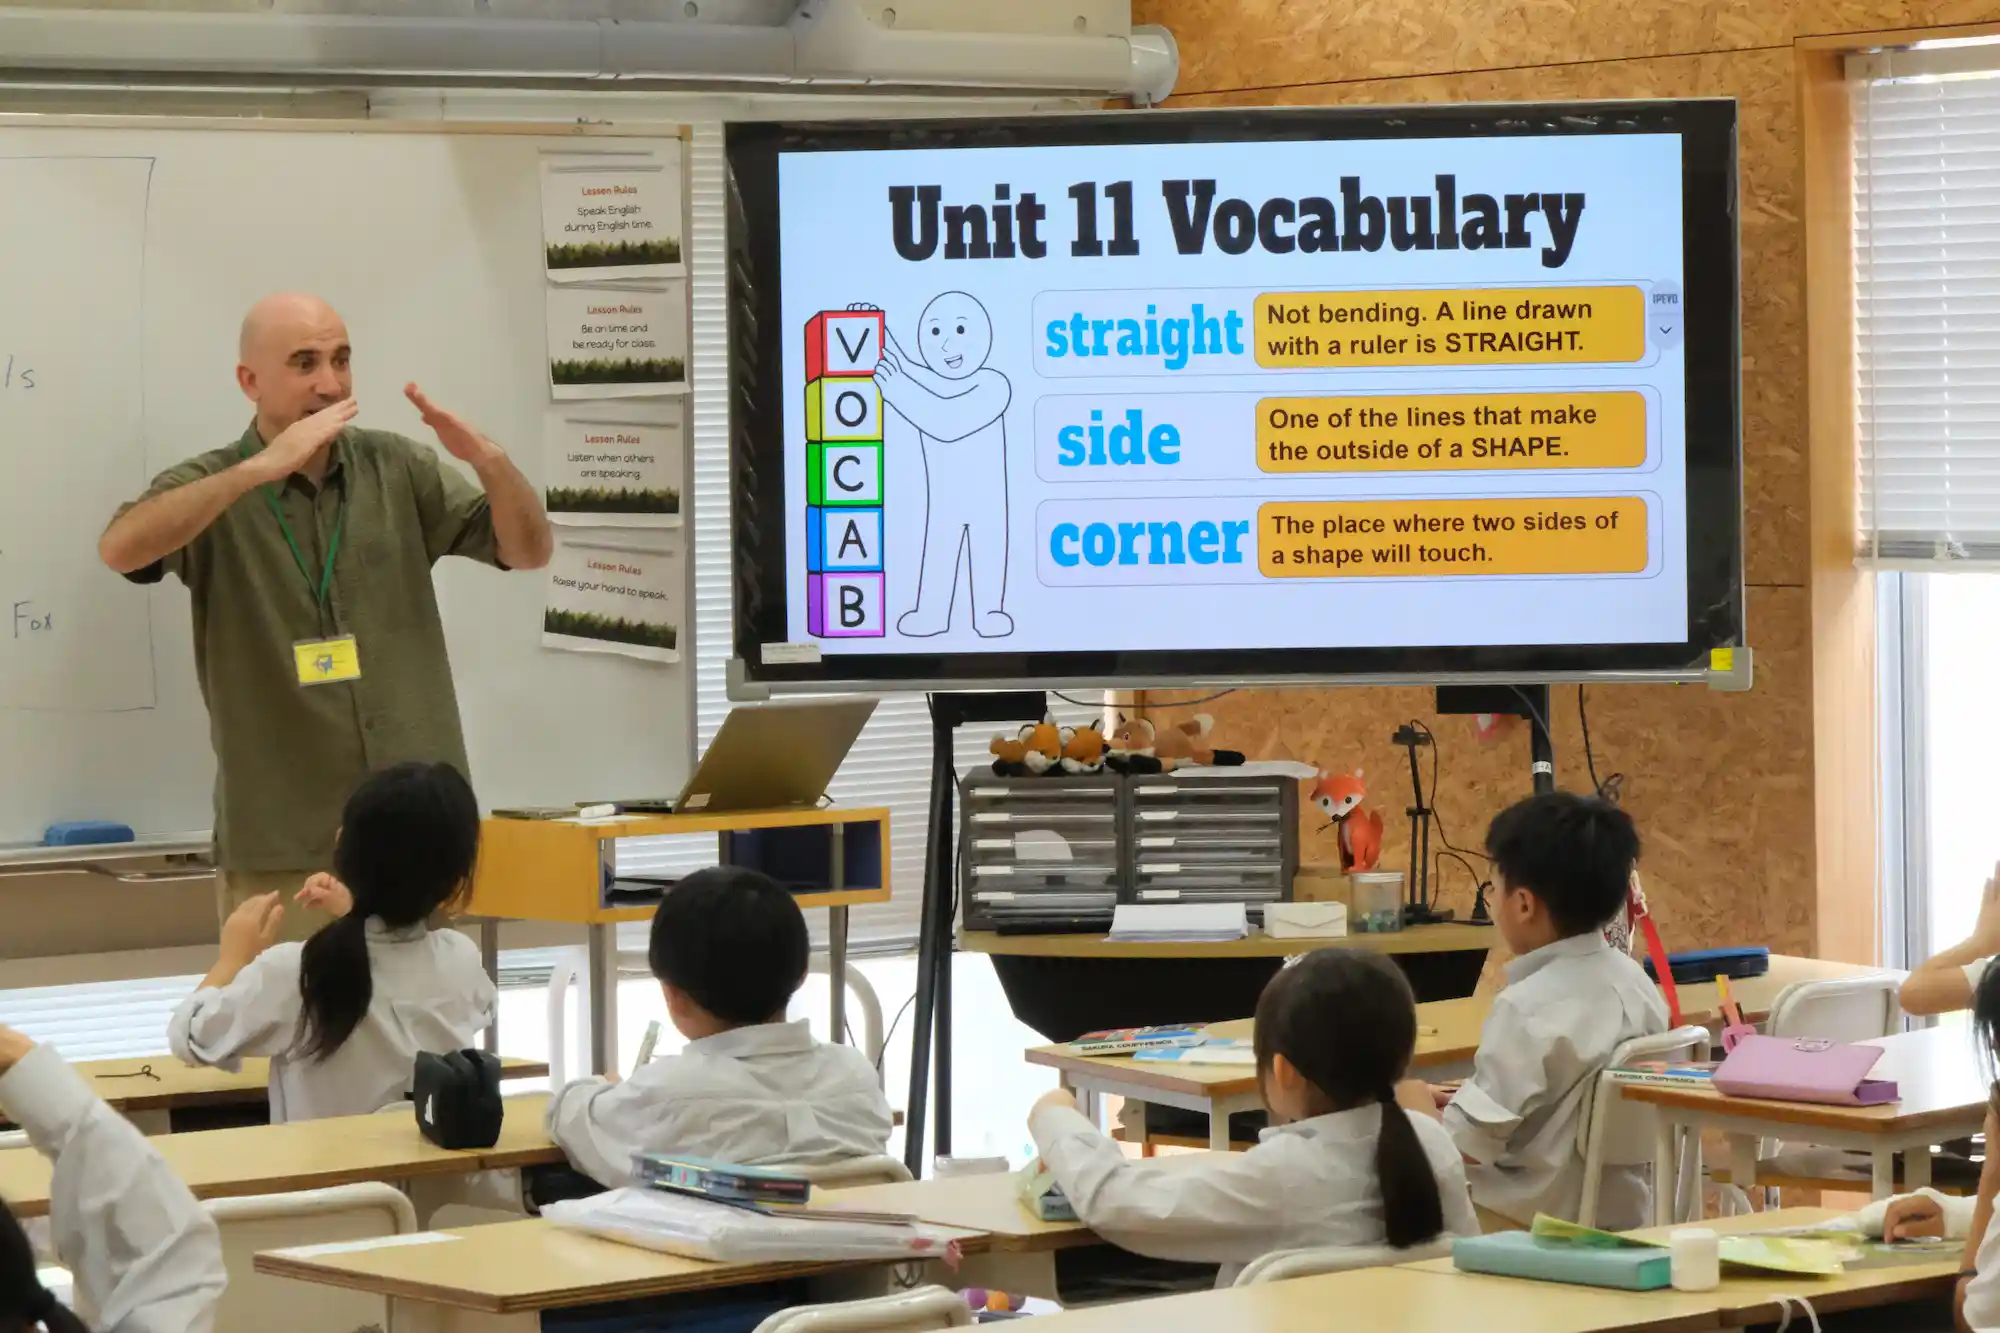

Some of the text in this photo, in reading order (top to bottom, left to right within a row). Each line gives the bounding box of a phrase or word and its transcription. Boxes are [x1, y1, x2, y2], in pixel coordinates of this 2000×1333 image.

[582, 186, 638, 196] Lesson Rules
[577, 204, 641, 217] Speak English
[888, 174, 1586, 269] Unit 11 Vocabulary
[564, 222, 596, 233] during
[597, 220, 630, 232] English
[587, 304, 644, 315] Lesson Rules
[1268, 299, 1593, 327] Not bending. A line drawn
[581, 324, 593, 334] Be
[608, 324, 628, 333] time
[629, 323, 648, 333] and
[1046, 303, 1245, 371] straight
[572, 340, 585, 349] be
[586, 340, 614, 351] ready
[615, 339, 629, 348] for
[1267, 330, 1584, 356] with a ruler is STRAIGHT.
[1269, 404, 1597, 429] One of the lines that make
[584, 434, 641, 444] Lesson Rules
[1057, 408, 1181, 467] side
[1269, 436, 1569, 461] the outside of a SHAPE.
[567, 453, 655, 463] Listen when others
[1271, 510, 1619, 539] The place where two sides of
[1049, 519, 1250, 567] corner
[587, 559, 642, 576] Lesson Rules
[1271, 543, 1493, 569] a shape will touch.
[552, 575, 577, 588] Raise
[578, 581, 599, 592] your
[601, 582, 625, 596] hand
[626, 587, 637, 596] to
